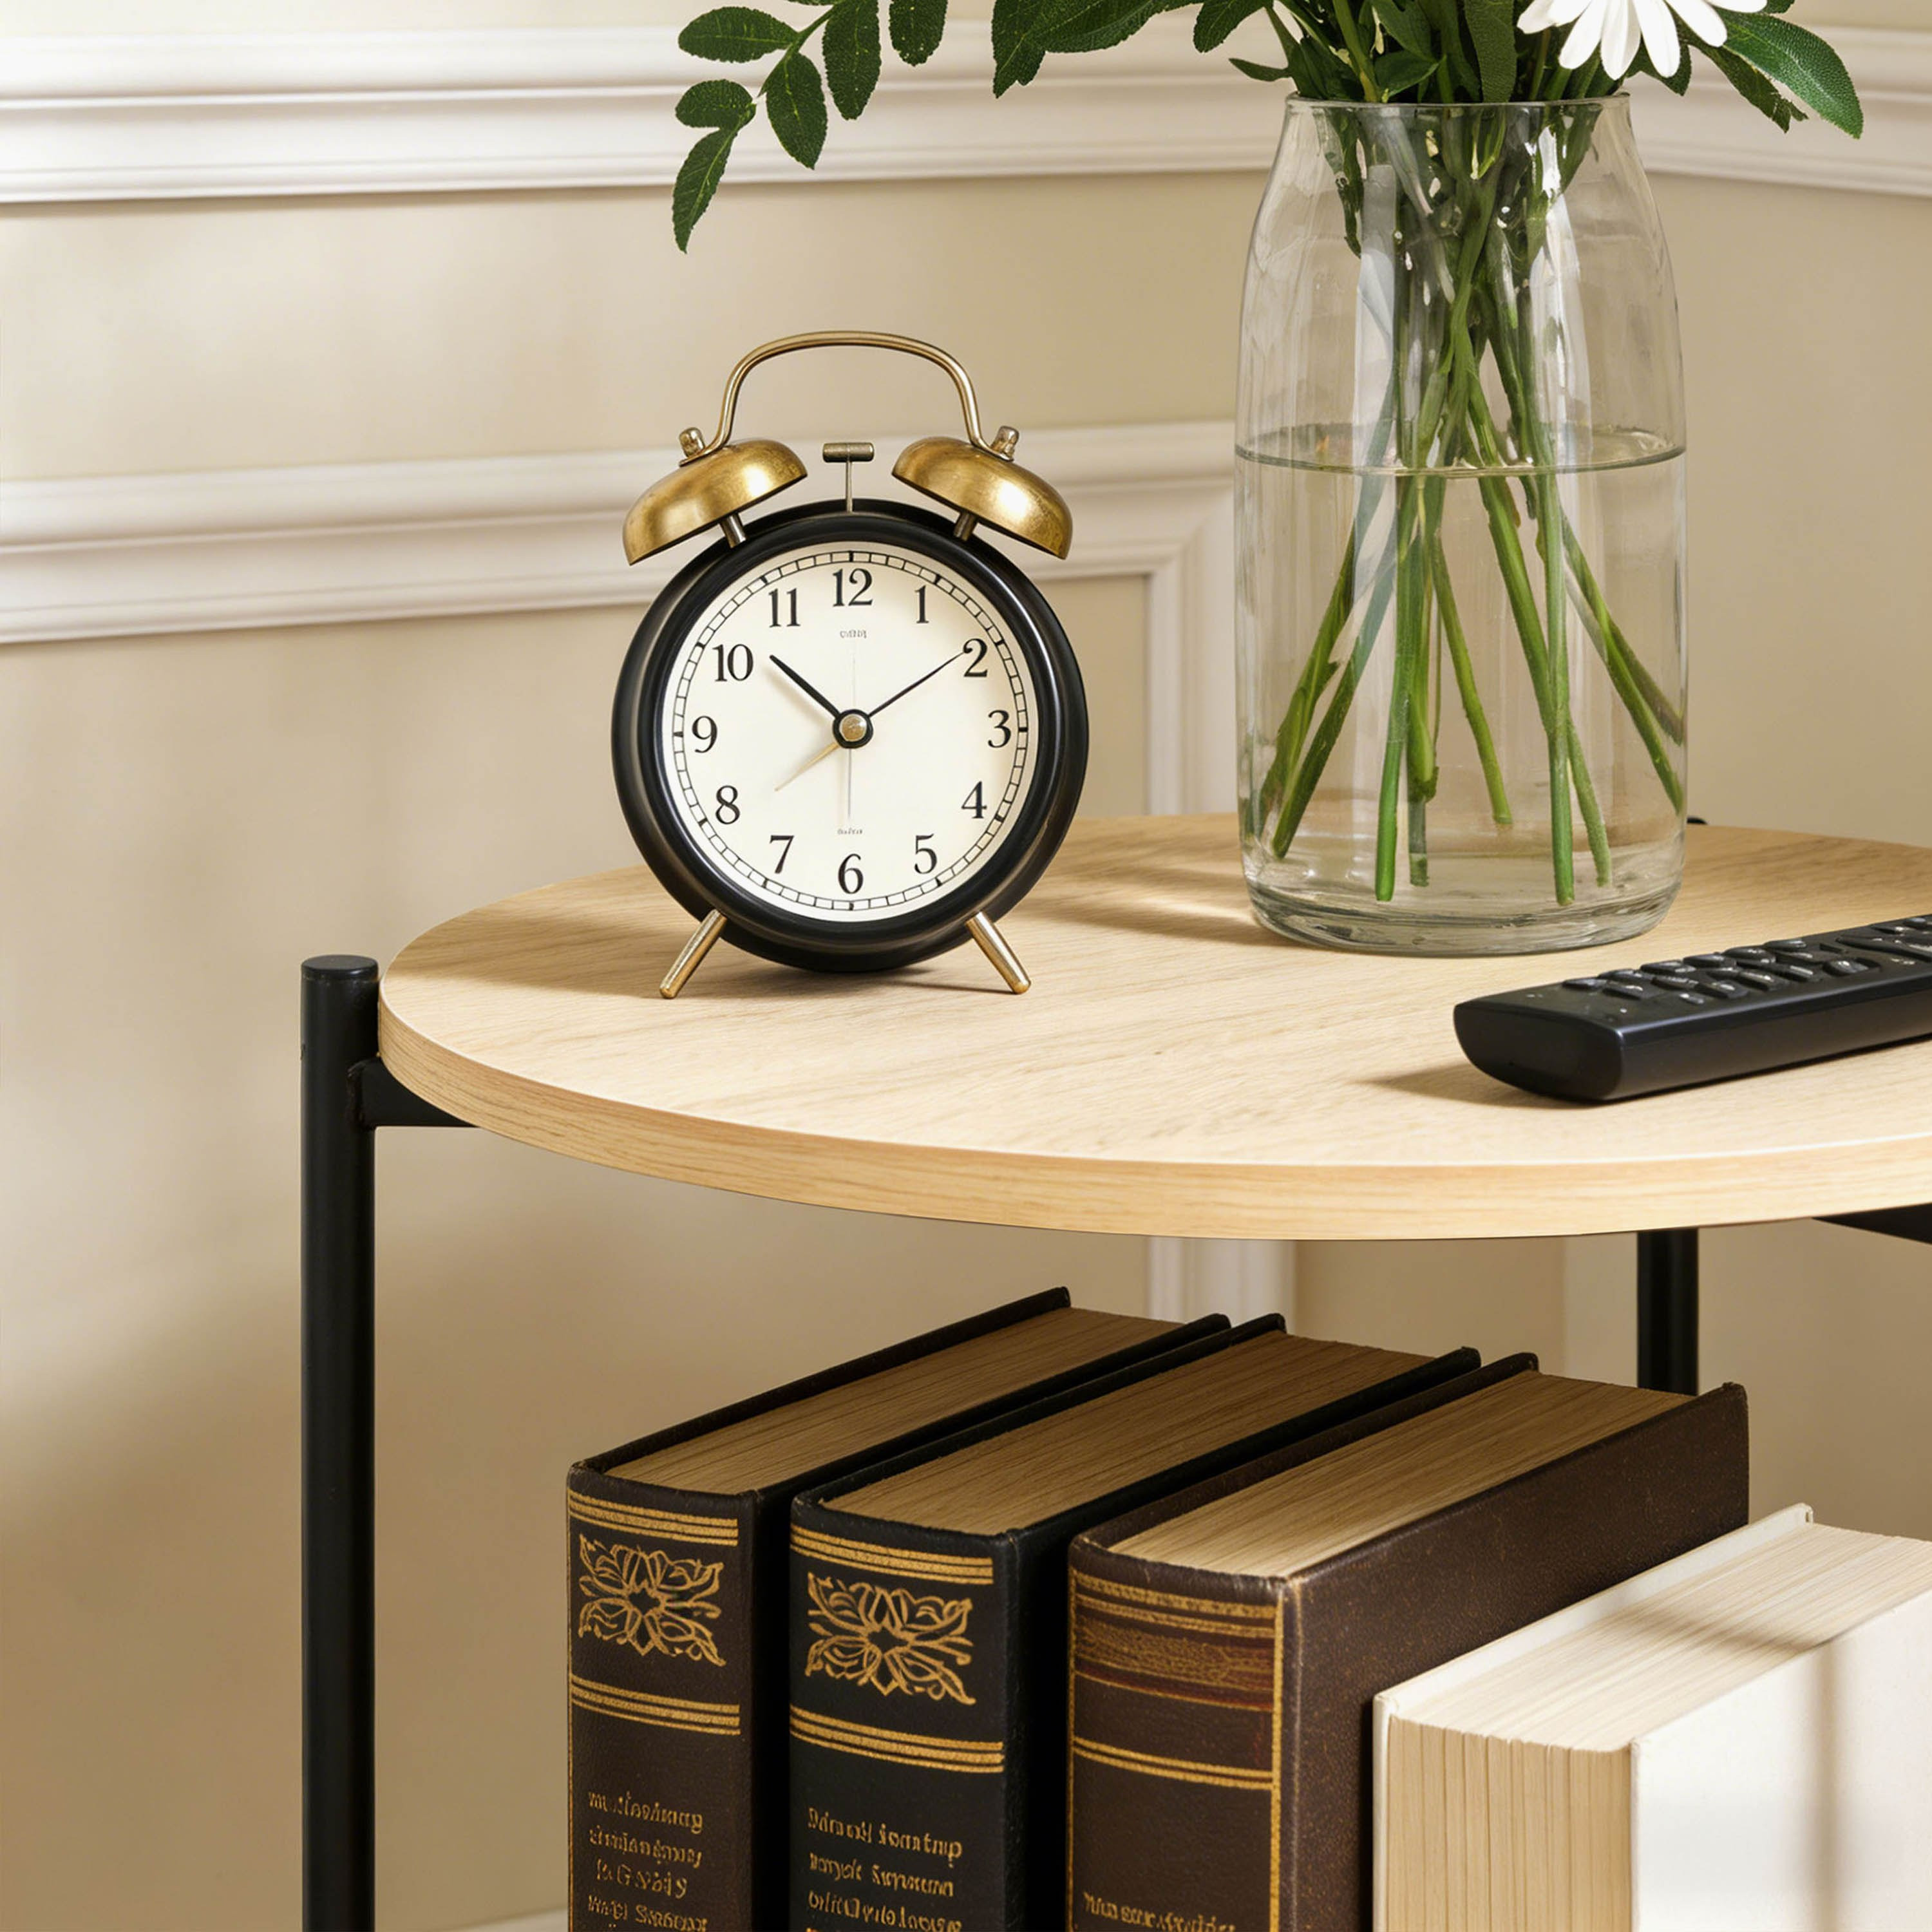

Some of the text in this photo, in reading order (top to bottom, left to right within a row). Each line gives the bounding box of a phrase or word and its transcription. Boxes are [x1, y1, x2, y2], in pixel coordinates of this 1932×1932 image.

[832, 568, 873, 607] 12
[915, 585, 929, 624] 1
[768, 588, 800, 628] 11
[713, 643, 753, 682] 10
[962, 638, 988, 677] 2
[692, 715, 717, 753] 9
[987, 709, 1012, 748] 3
[715, 785, 741, 825] 8
[961, 781, 987, 819] 4
[770, 835, 794, 874] 7
[914, 834, 937, 874] 5
[838, 853, 864, 895] 6
